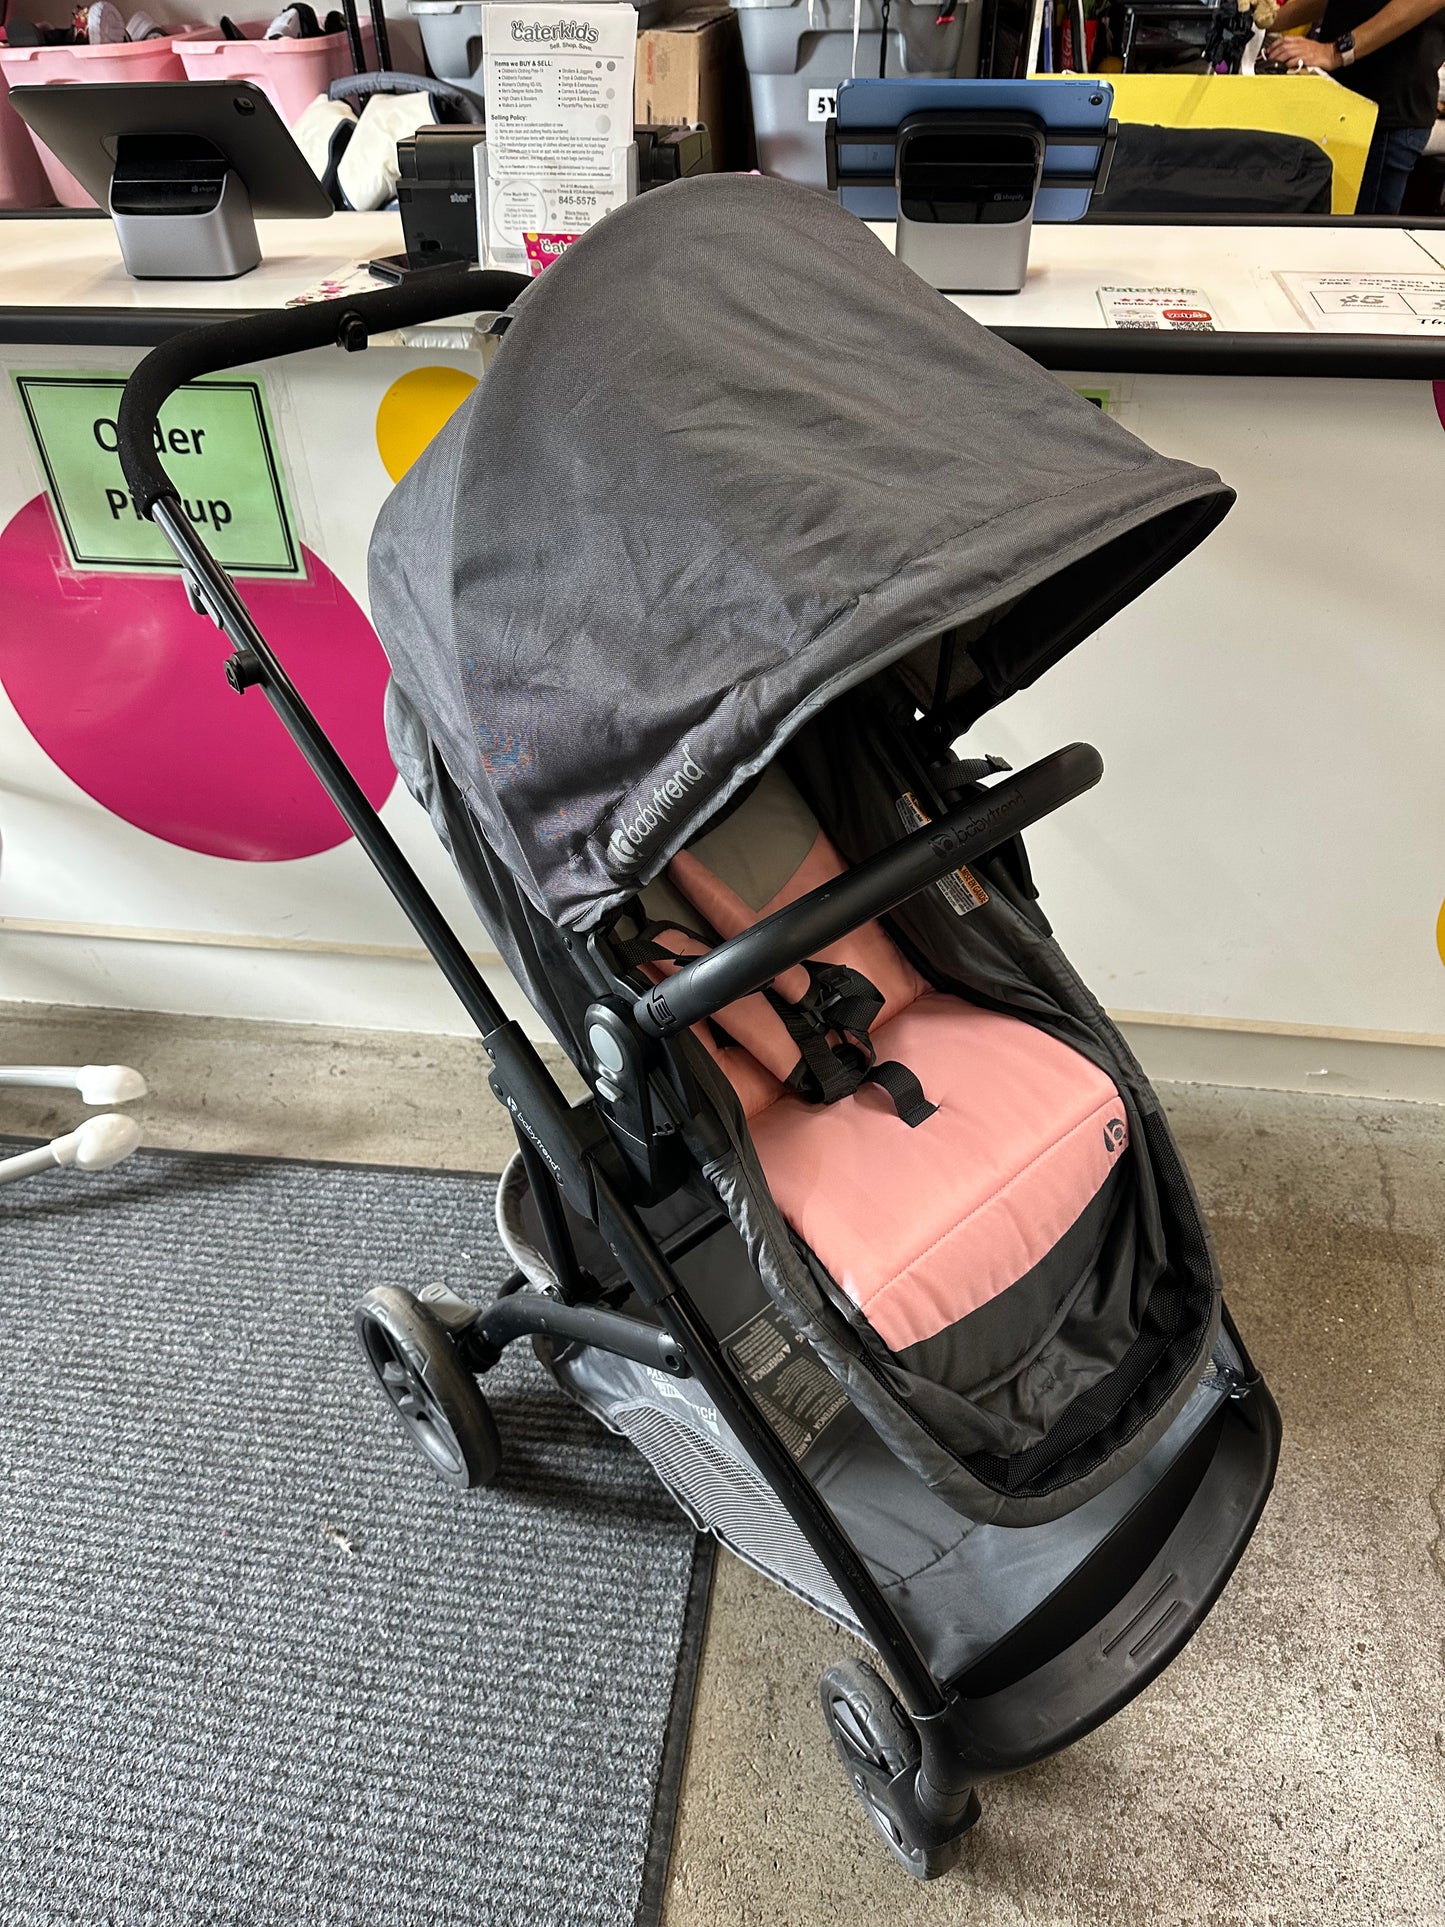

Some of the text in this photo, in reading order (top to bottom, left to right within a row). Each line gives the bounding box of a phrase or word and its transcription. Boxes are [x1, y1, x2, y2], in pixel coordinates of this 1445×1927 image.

[558, 196, 596, 205] 845-5575
[1340, 294, 1385, 304] $5
[93, 418, 205, 454] Oder
[621, 745, 706, 845] babytrend
[951, 789, 1024, 842] babytrend
[517, 1112, 560, 1170] babytrend
